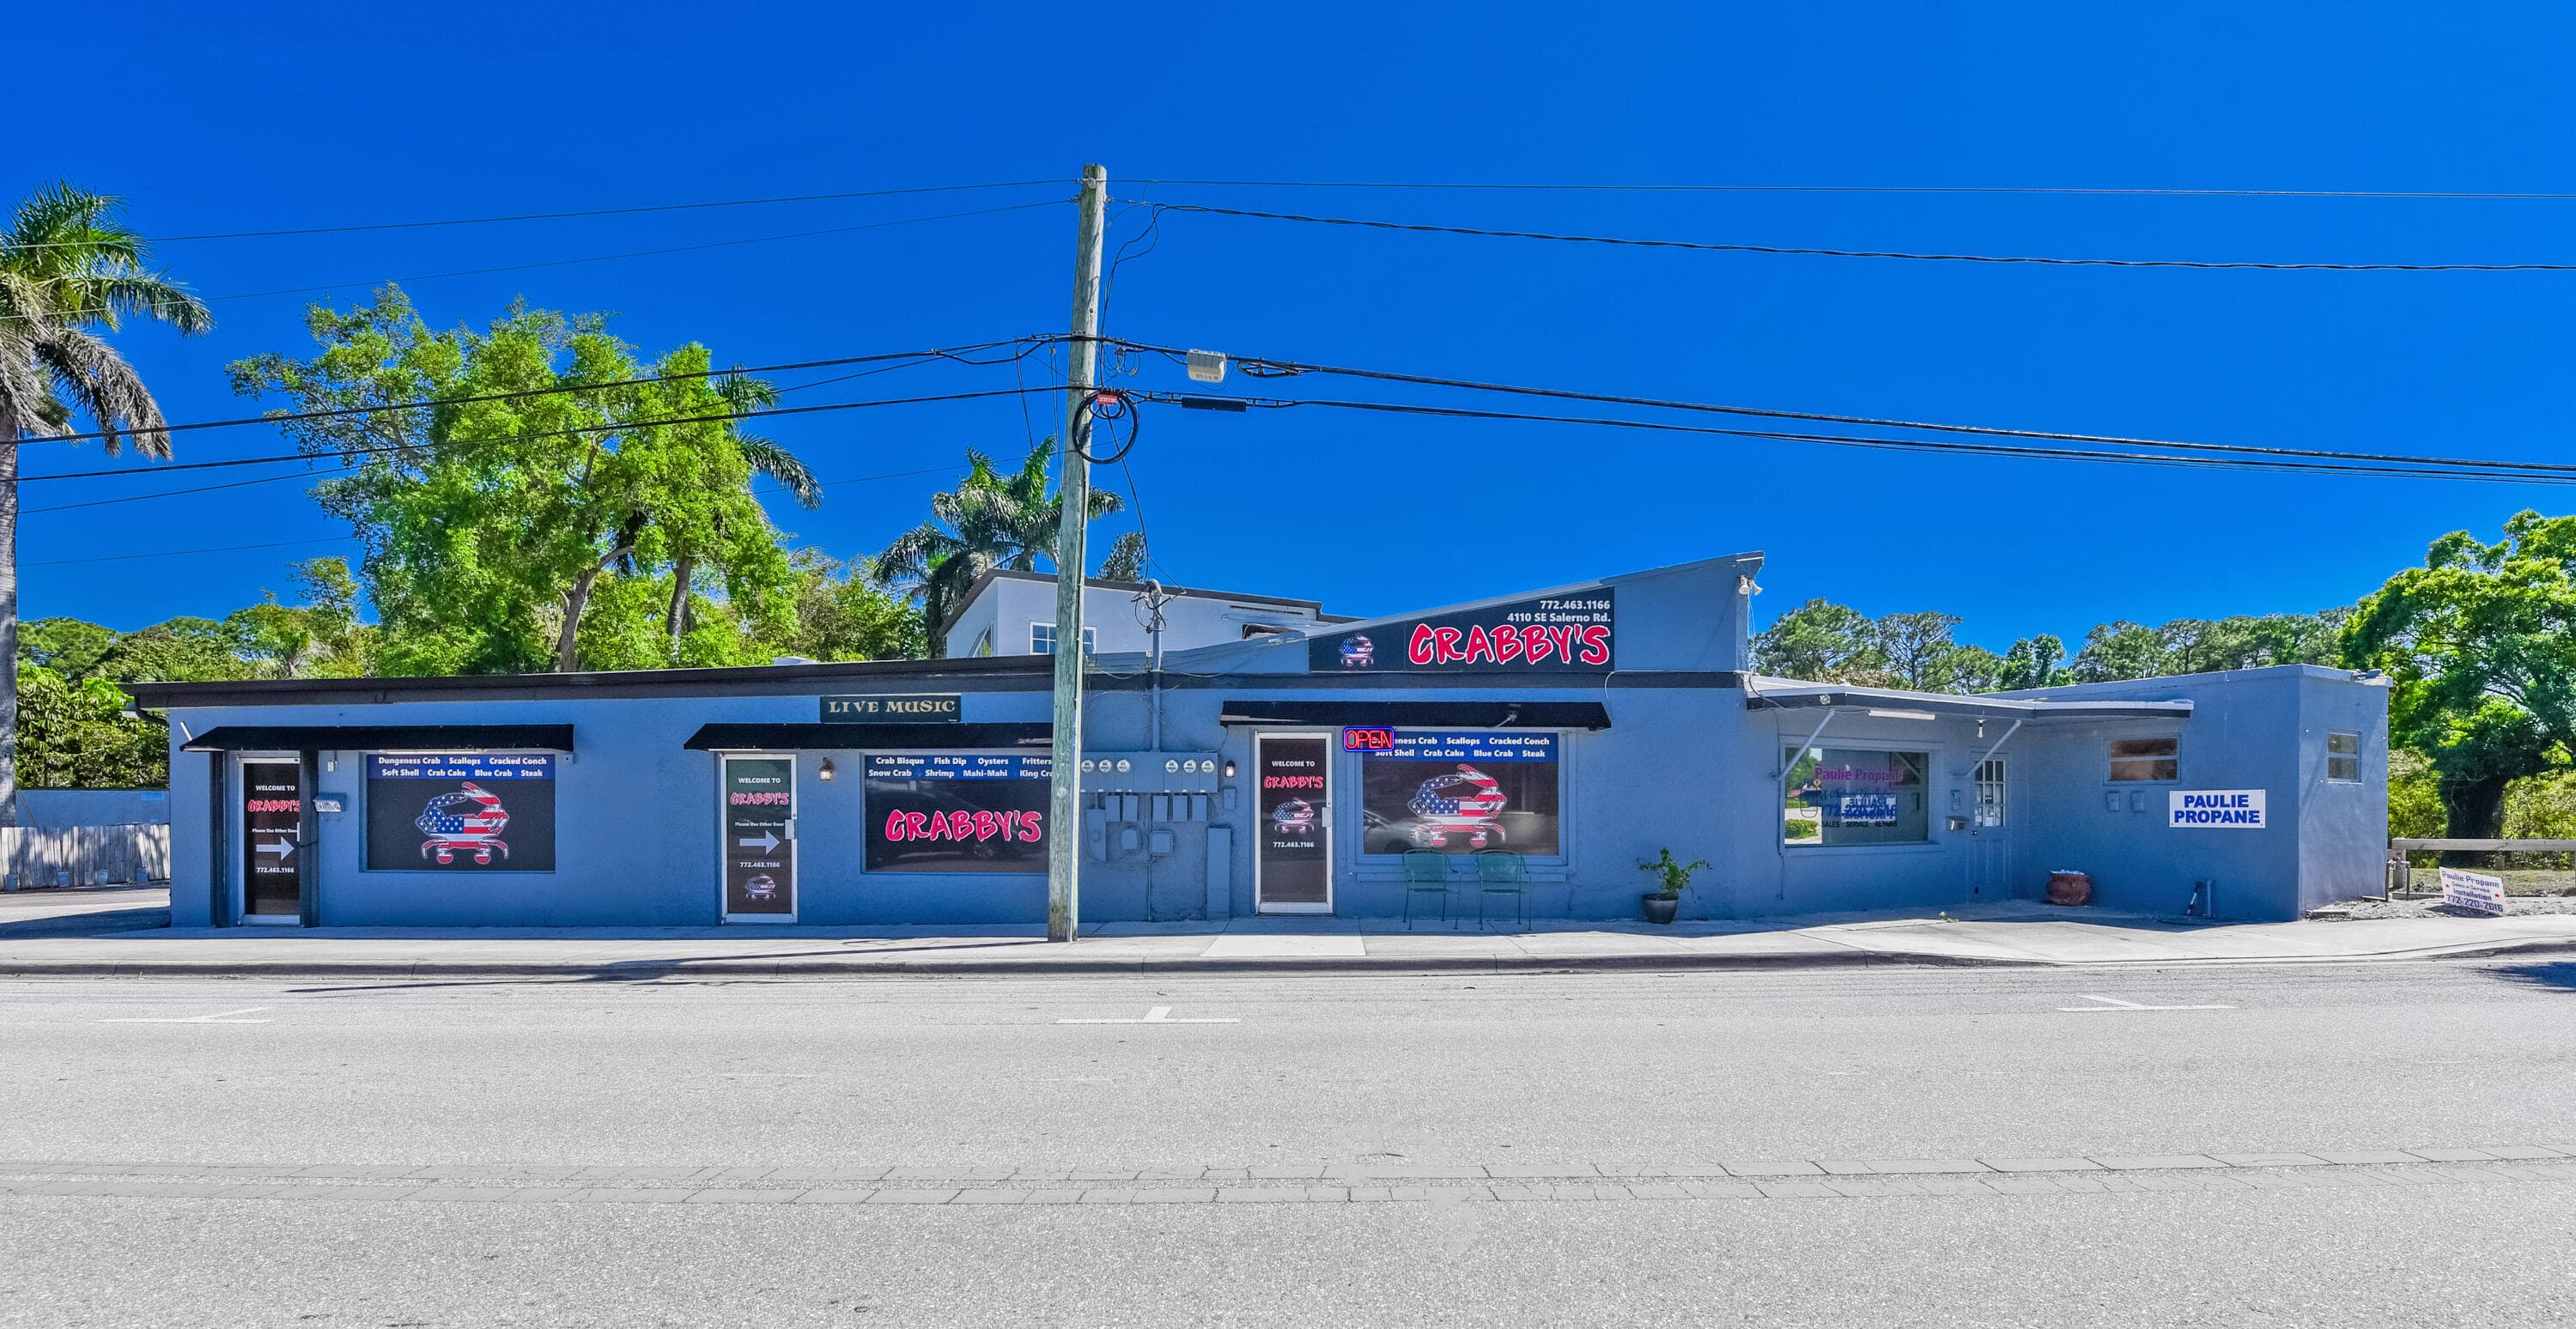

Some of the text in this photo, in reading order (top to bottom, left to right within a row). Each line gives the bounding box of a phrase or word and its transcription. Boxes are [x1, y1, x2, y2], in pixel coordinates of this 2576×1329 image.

[1540, 600, 1610, 610] 772.463.1166
[1507, 613, 1611, 622] 4110 SE Salerno Rd.
[1408, 623, 1611, 664] CRABBY'S
[829, 701, 955, 713] LIVE MUSIC
[1346, 730, 1392, 749] OPEN
[1419, 737, 1437, 745] Crab
[1446, 737, 1480, 746] Scallops
[1489, 737, 1522, 745] Cracked
[1523, 737, 1549, 745] Conch
[1394, 749, 1414, 757] Shell
[1424, 749, 1443, 757] Crab
[1444, 749, 1465, 757] Cake
[1473, 749, 1492, 757] Blue
[1494, 749, 1513, 757] Crab
[1522, 749, 1546, 757] Steak
[378, 757, 421, 766] Dungeness
[449, 757, 481, 766] Scallops
[896, 757, 924, 766] Bisque
[952, 757, 966, 766] Dip
[977, 757, 1008, 766] Oysters
[926, 769, 955, 778] Shrimp
[1020, 769, 1039, 779] King
[1815, 768, 1903, 783] Paulie Propane
[1264, 776, 1323, 788] CRABBY'S
[730, 792, 789, 805] CRABBY'S
[2184, 795, 2249, 807] PAULIE
[247, 798, 301, 812] CRABBY'S
[2174, 810, 2260, 823] PROPANE
[884, 809, 1042, 842] CRABBY'S
[2442, 871, 2500, 888] Paulie Propane
[2453, 889, 2492, 901] Installation
[2446, 895, 2503, 912] 772-220-2616
